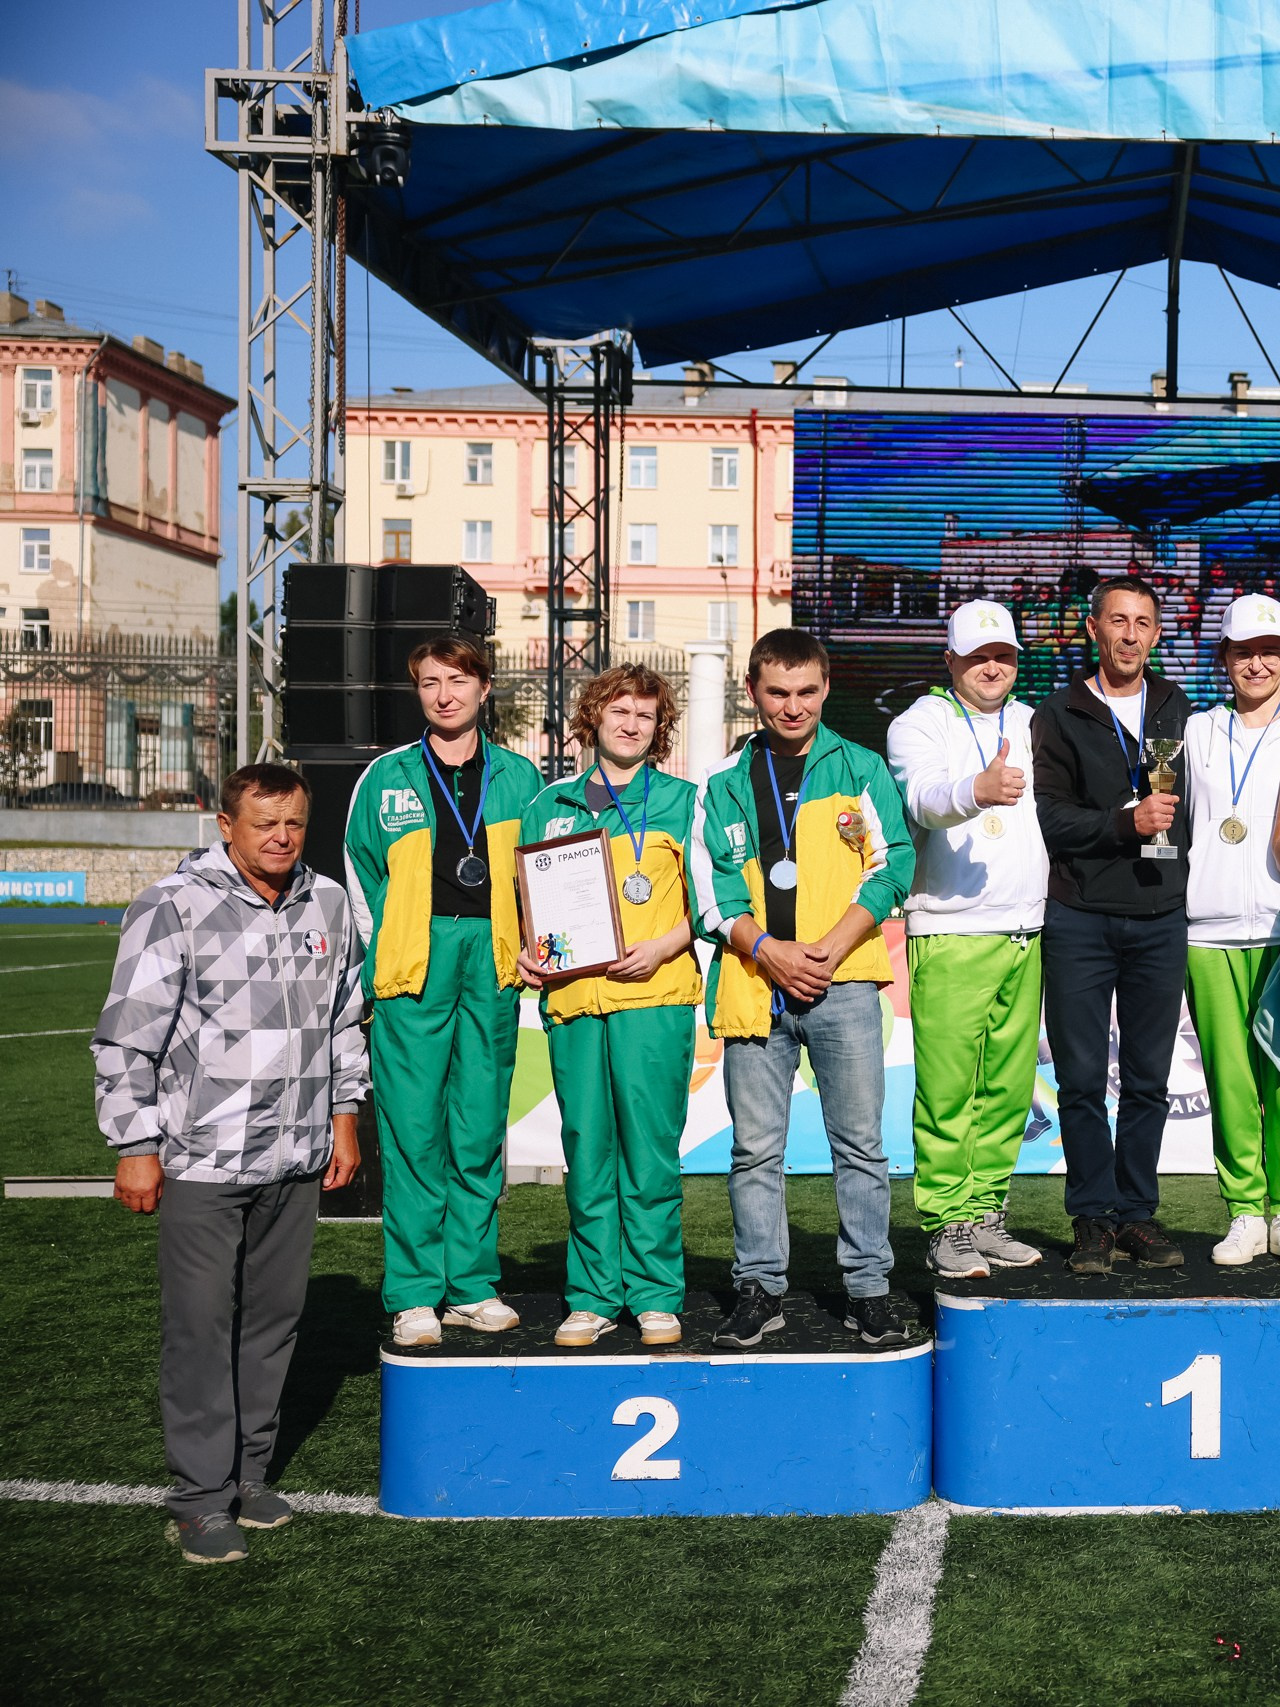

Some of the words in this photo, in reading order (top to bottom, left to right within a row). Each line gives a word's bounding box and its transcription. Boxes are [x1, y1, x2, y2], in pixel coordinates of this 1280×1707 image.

[381, 788, 424, 814] ГКЗ
[557, 847, 601, 863] ГРАМОТА
[1161, 1354, 1221, 1460] 1
[610, 1396, 680, 1481] 2
